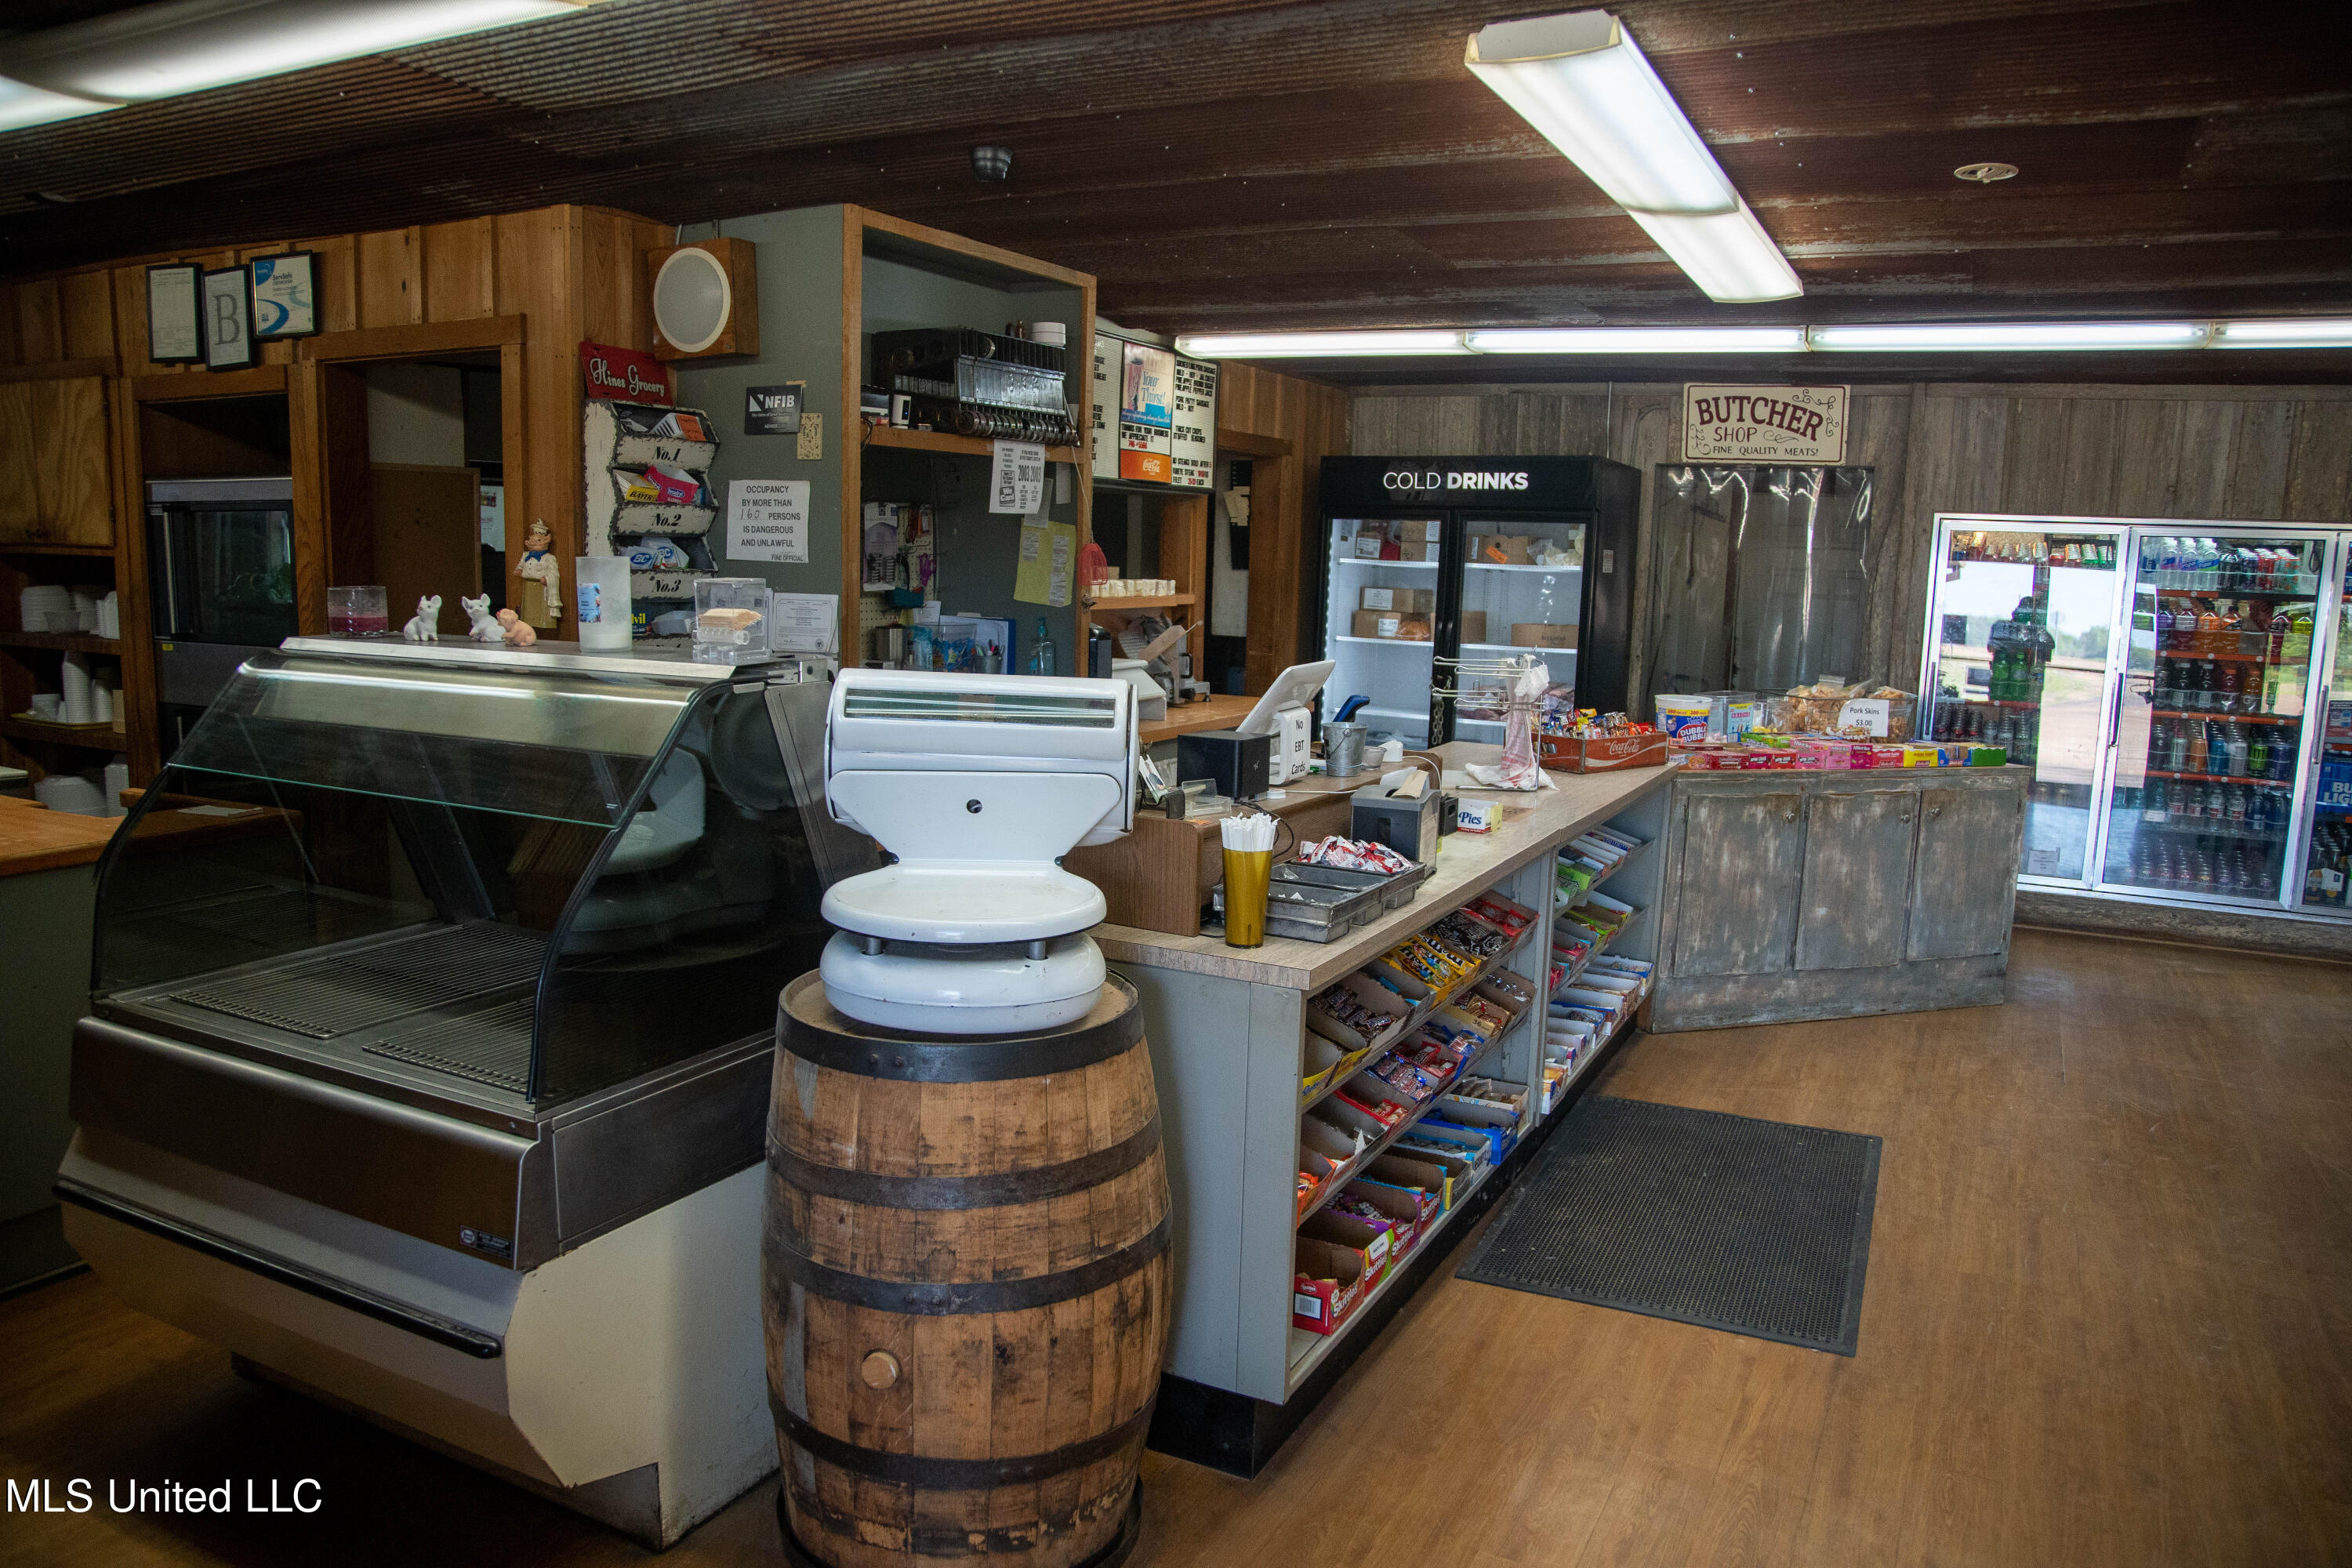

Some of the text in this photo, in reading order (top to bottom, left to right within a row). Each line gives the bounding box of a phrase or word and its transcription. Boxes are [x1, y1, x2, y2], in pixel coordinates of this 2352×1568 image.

[212, 294, 240, 346] B
[590, 358, 665, 397] Hines Grocery
[765, 394, 795, 408] NFIB
[1695, 396, 1824, 441] BUTCHER
[1713, 426, 1758, 443] SHOP
[1713, 445, 1819, 456] FINE QUALITY MEATS!
[1383, 472, 1529, 490] COLD DRINKS
[630, 491, 653, 501] BAYER
[652, 513, 682, 527] No.2
[757, 539, 794, 547] UNLAWFUL
[633, 554, 650, 563] BC
[659, 548, 672, 557] BC
[652, 579, 682, 593] No.3
[631, 613, 646, 624] vil
[1296, 720, 1303, 730] No
[1680, 726, 1707, 737] DUBBLE
[1295, 740, 1305, 752] EBT
[1291, 761, 1305, 775] Cards
[2332, 782, 2352, 793] BU
[2323, 791, 2352, 803] LIG
[1459, 811, 1482, 825] Pies
[1392, 1229, 1414, 1256] Skittles
[1364, 1255, 1388, 1281] Skittles
[1333, 1284, 1358, 1318] Skittles
